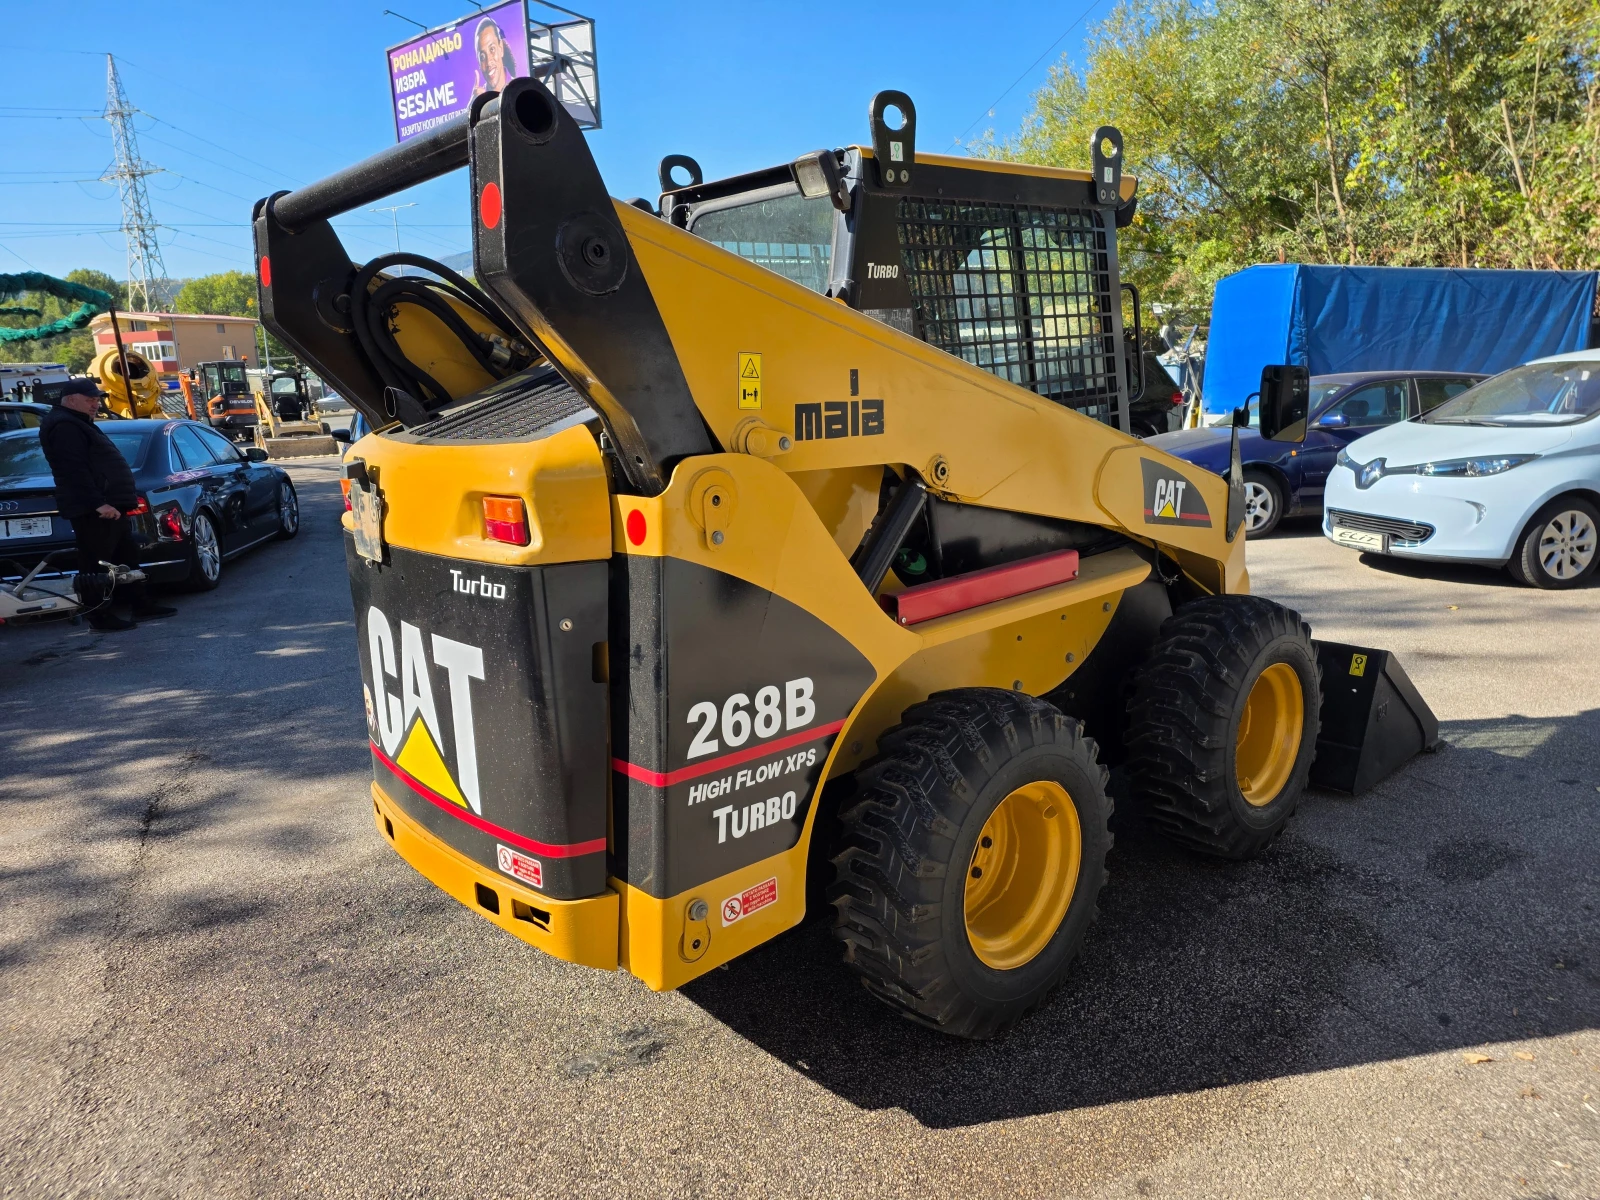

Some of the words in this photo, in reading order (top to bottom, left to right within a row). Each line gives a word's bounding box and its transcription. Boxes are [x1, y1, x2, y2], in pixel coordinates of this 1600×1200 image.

[393, 32, 462, 73] РОНАЛДИНЬО
[395, 69, 427, 94] ИЗБРА
[867, 262, 899, 279] TURBO
[1153, 478, 1187, 519] CAT
[449, 569, 506, 600] Turbo
[367, 605, 486, 816] CAT
[686, 676, 816, 760] 268B
[687, 774, 731, 806] HIGH
[735, 756, 783, 790] FLOW
[785, 748, 817, 774] XPS
[712, 790, 797, 844] TURBO
